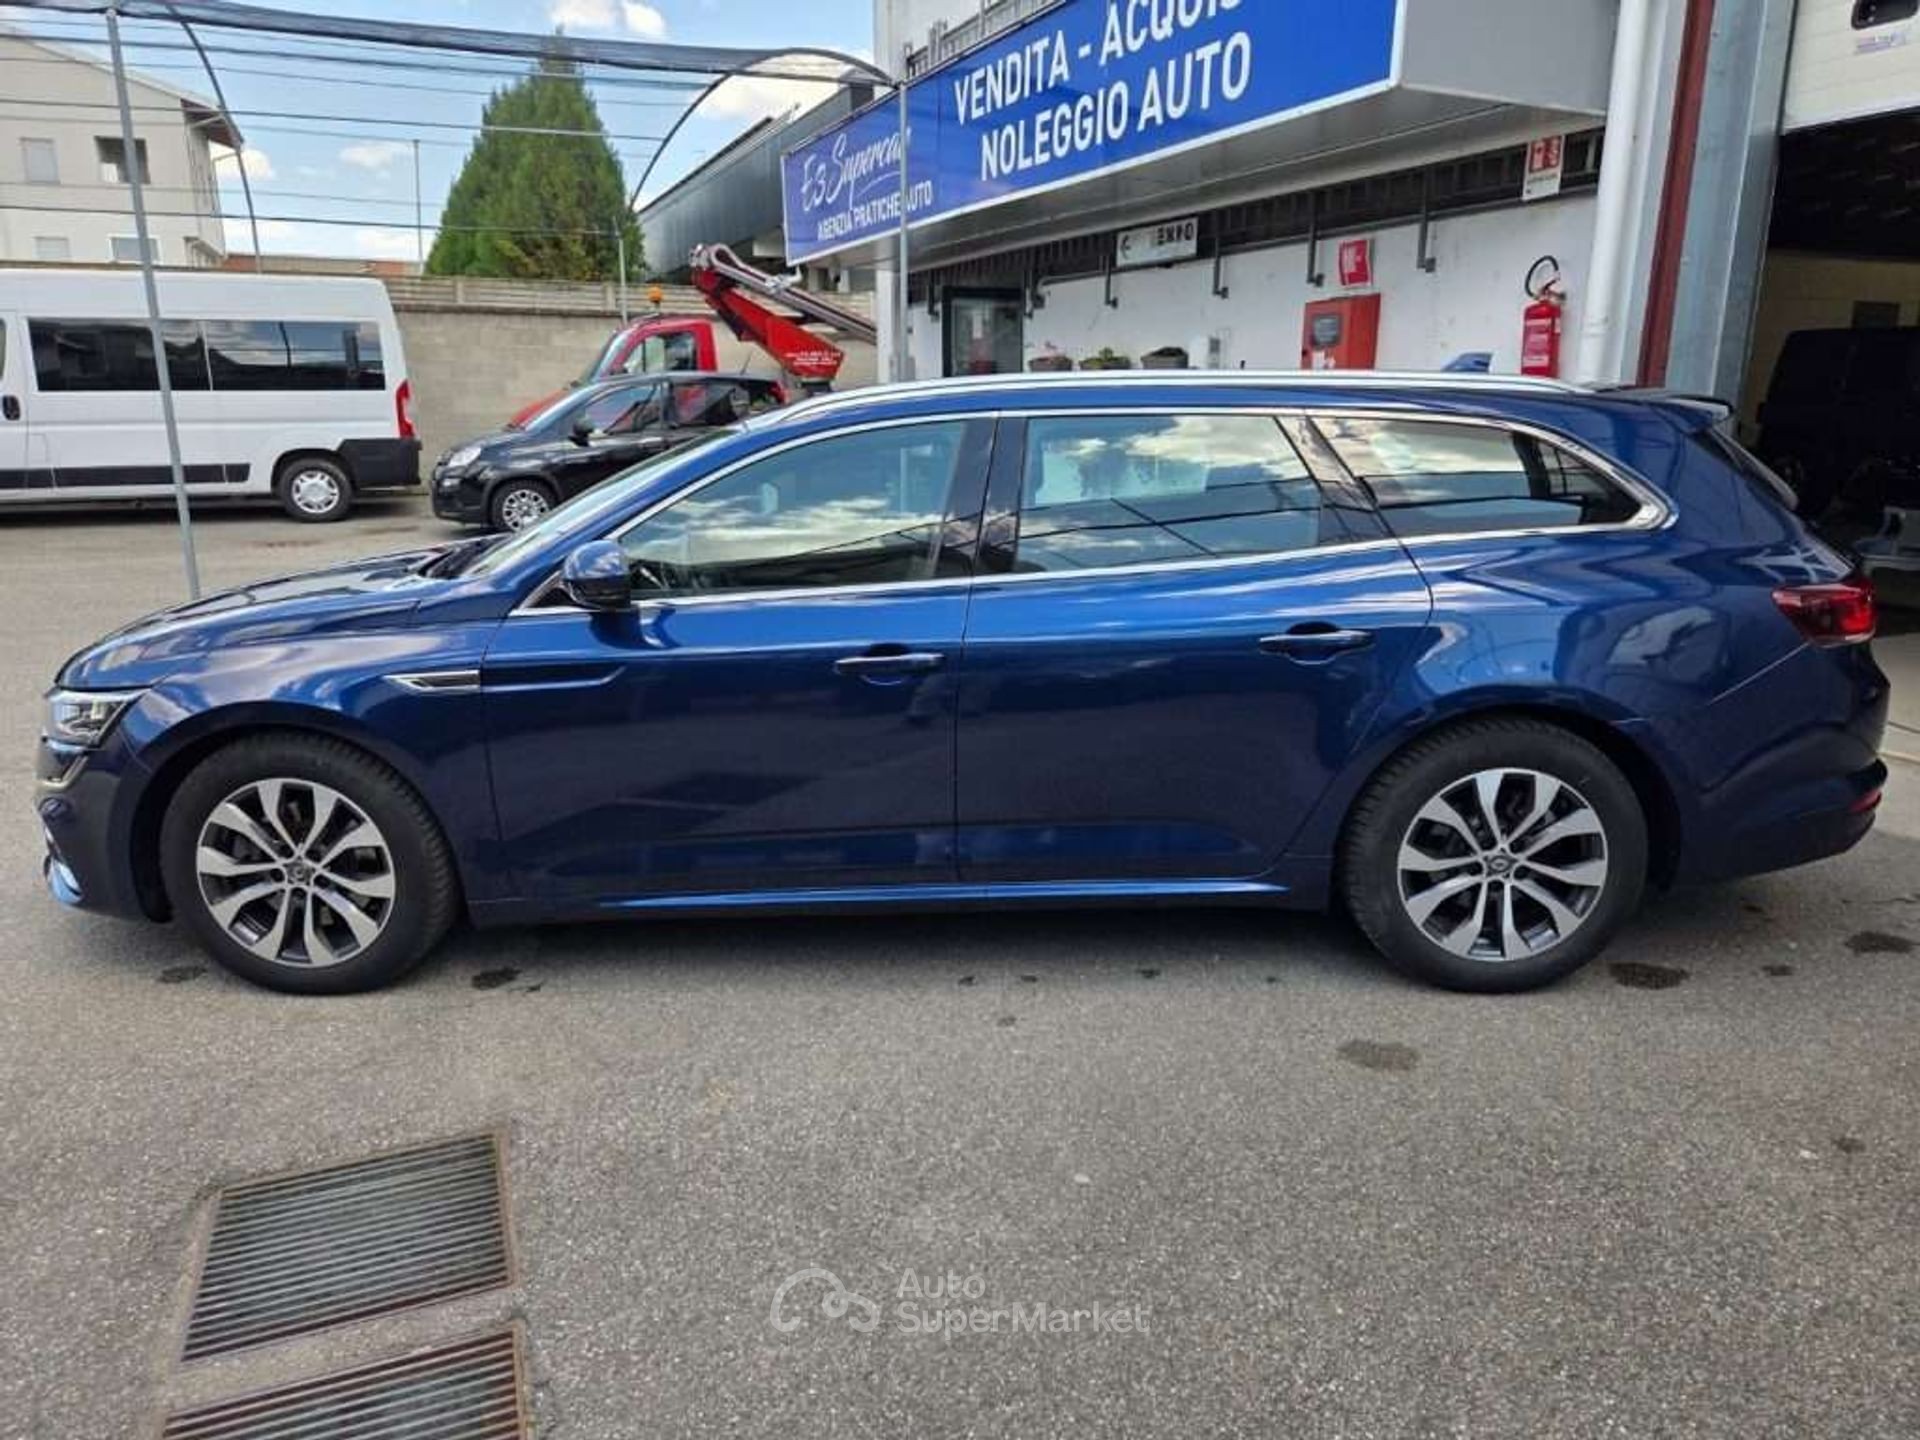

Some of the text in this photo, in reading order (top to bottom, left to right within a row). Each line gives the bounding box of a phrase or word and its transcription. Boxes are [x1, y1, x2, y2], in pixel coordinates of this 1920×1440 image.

[955, 0, 1241, 125] VENDITA - ACQ
[981, 31, 1251, 181] NOLEGGIO AUTO
[817, 210, 852, 241] AGENZIA
[853, 191, 901, 228] PRATICHE
[825, 127, 912, 210] Superca
